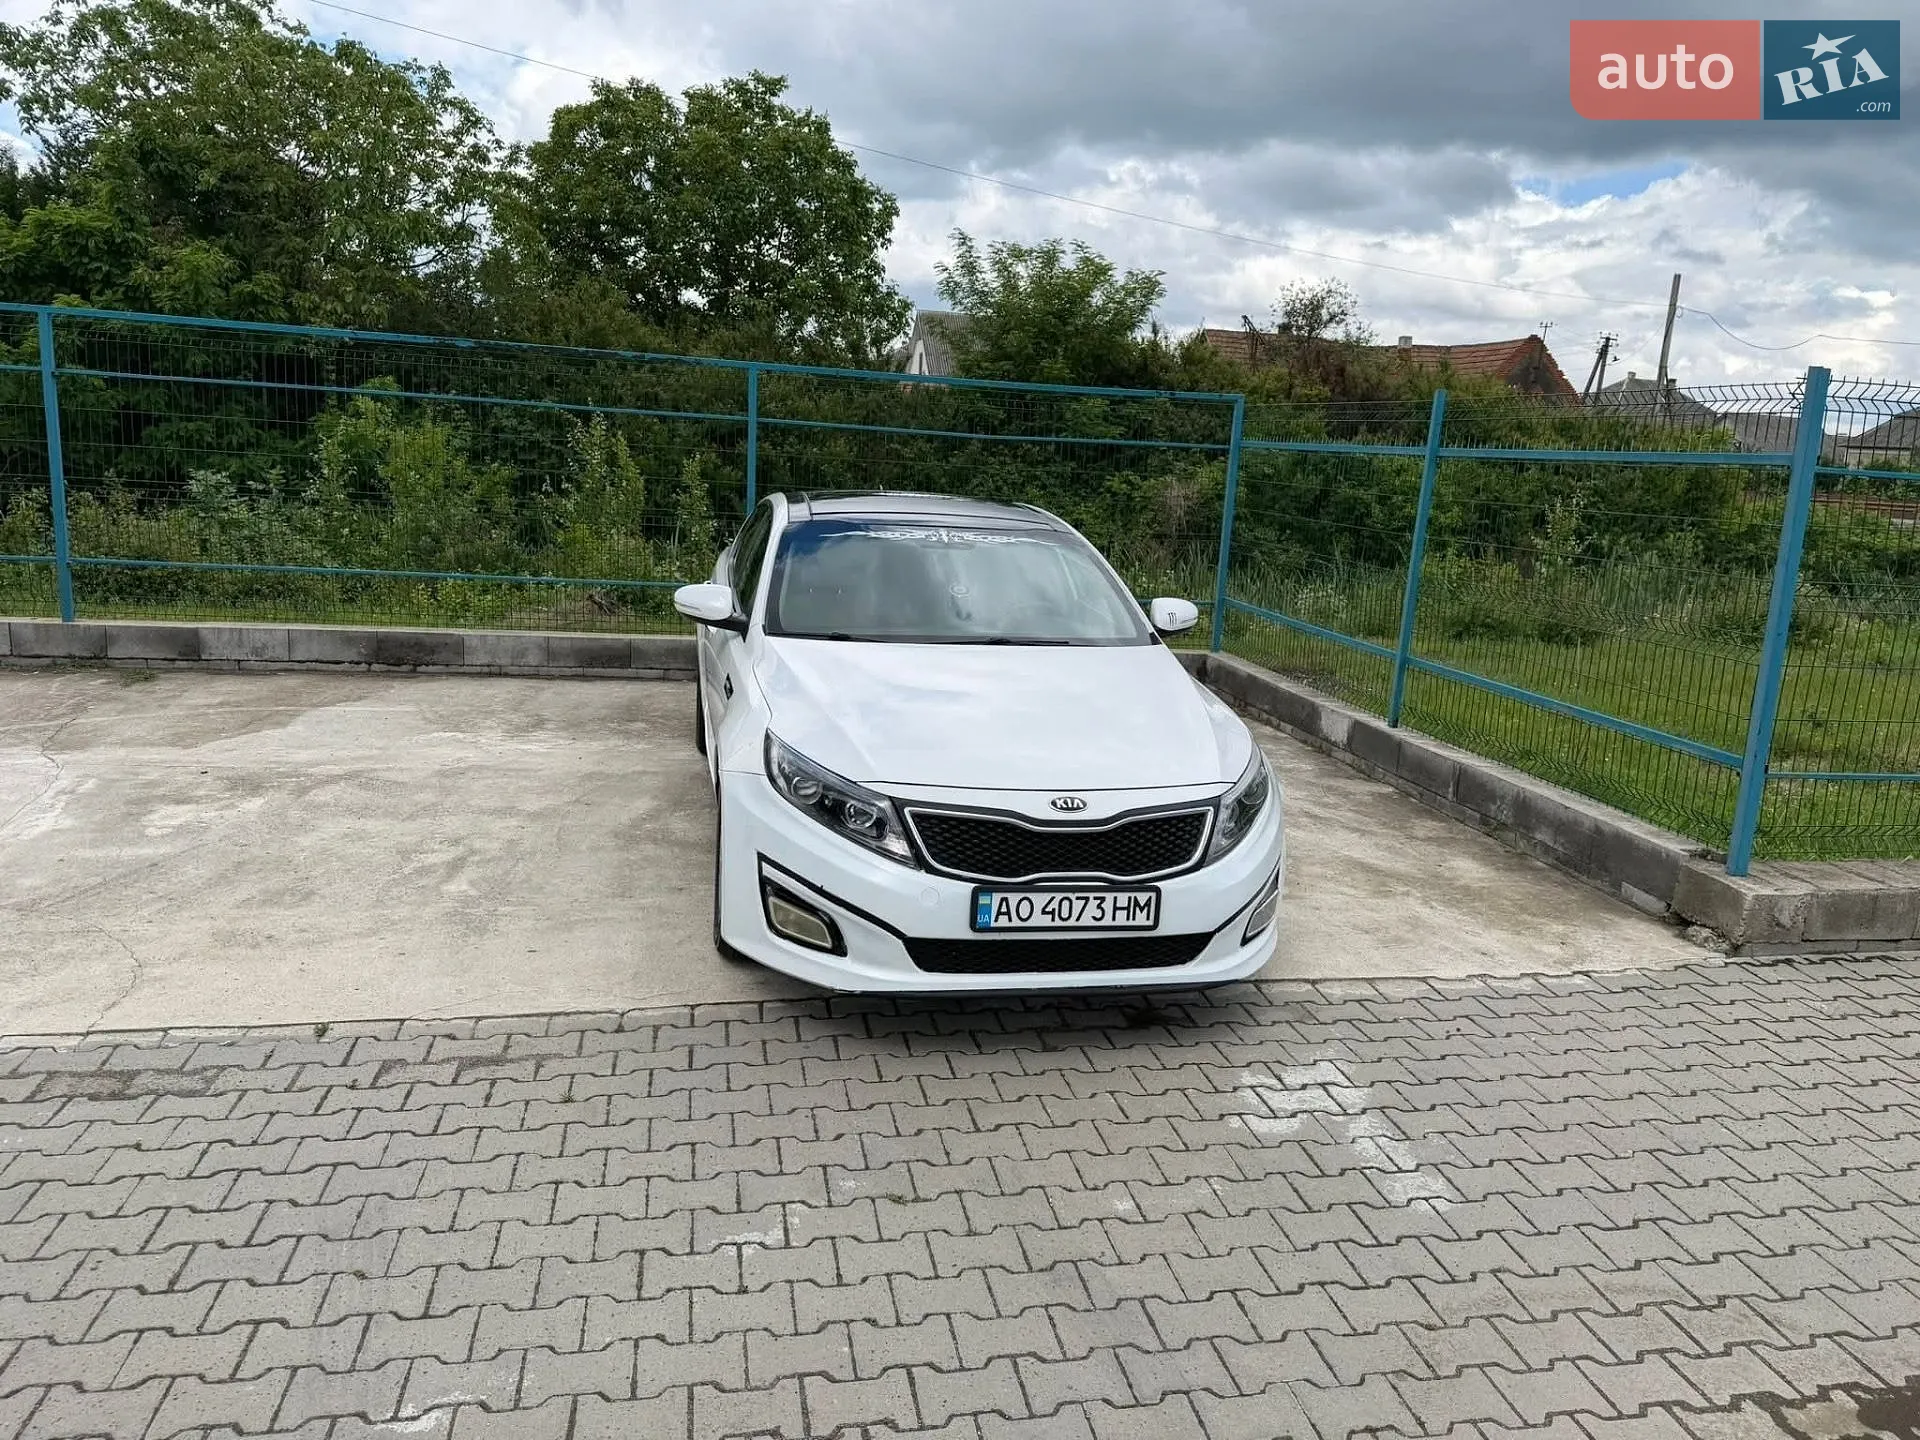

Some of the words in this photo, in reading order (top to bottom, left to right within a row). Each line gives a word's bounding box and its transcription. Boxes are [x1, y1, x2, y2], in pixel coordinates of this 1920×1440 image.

[1055, 798, 1084, 808] KIA
[994, 896, 1035, 923] AO
[1041, 896, 1107, 922] 4073
[1112, 895, 1153, 922] HM
[977, 914, 990, 923] UA
